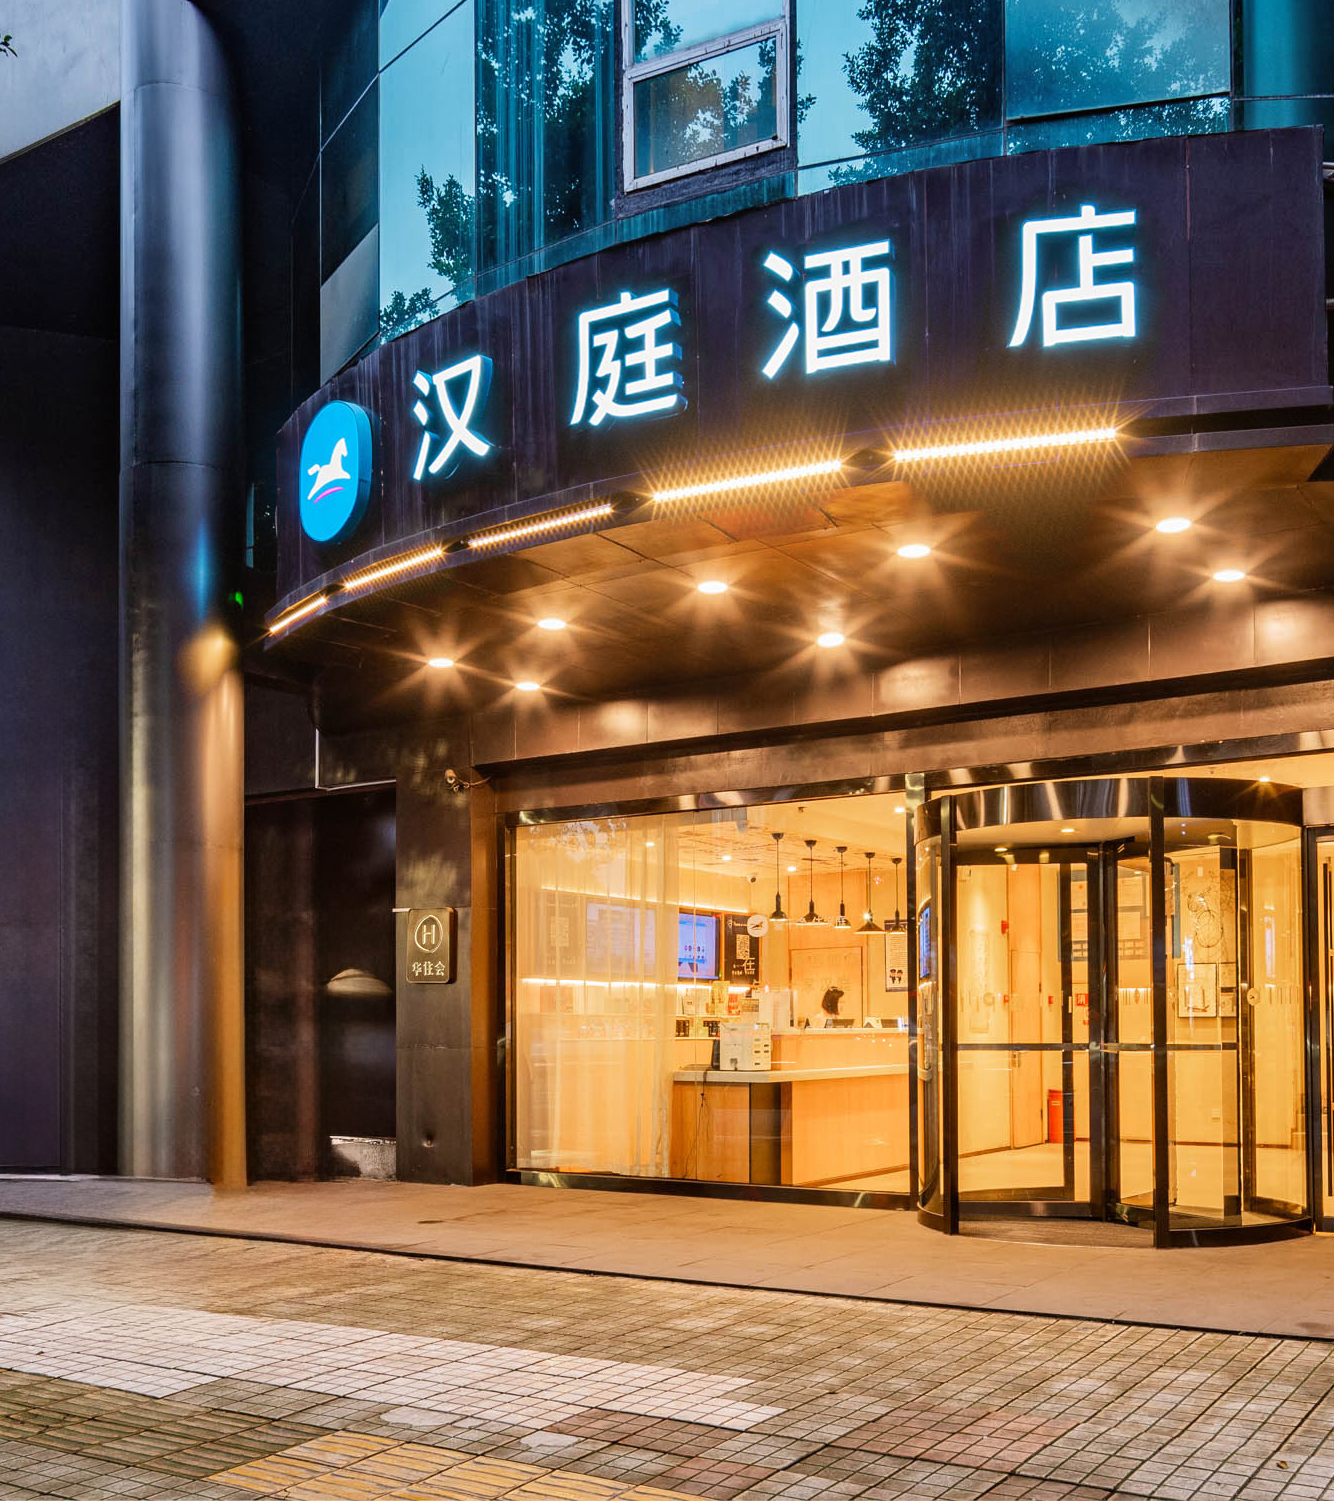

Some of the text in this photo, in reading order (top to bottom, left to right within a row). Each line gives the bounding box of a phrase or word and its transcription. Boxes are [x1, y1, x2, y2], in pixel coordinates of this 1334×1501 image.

[413, 205, 1137, 481] 汉庭酒店
[412, 961, 445, 976] 华住会
